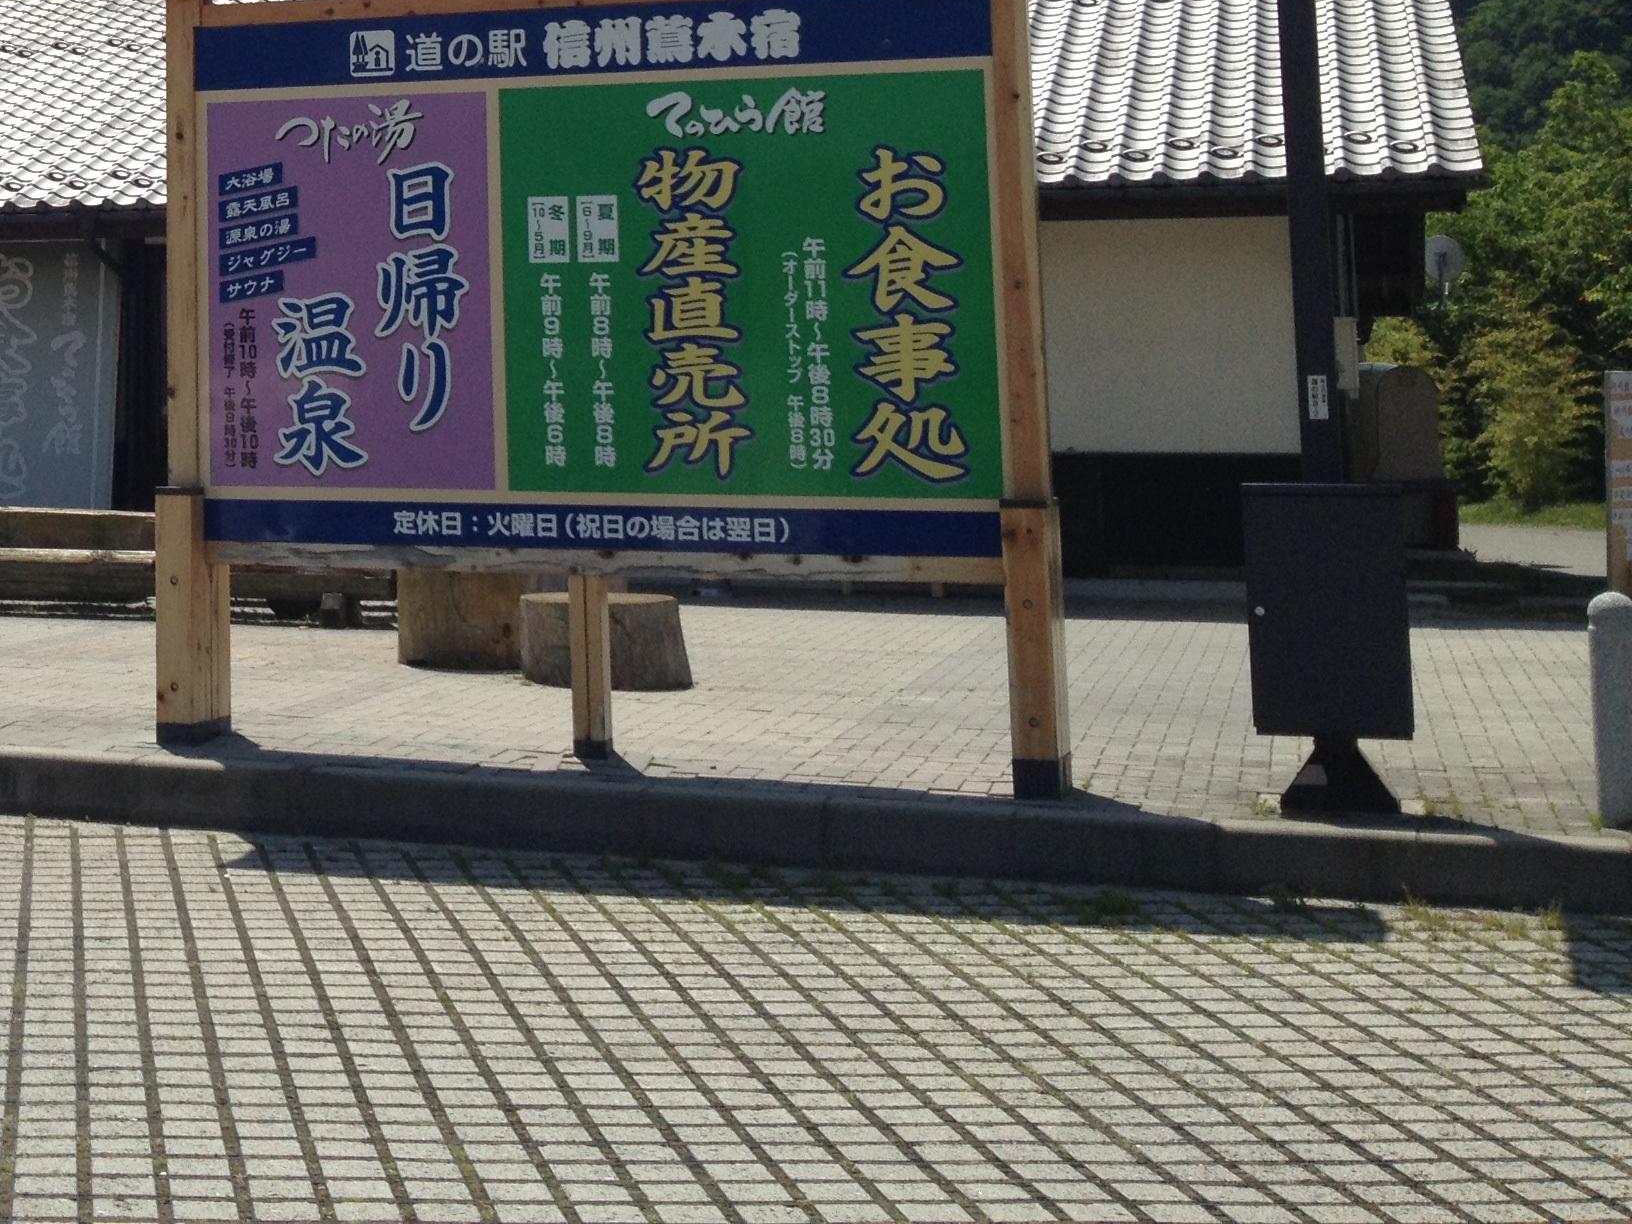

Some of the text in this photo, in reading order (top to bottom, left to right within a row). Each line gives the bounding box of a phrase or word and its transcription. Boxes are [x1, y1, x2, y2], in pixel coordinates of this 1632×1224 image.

[405, 9, 801, 73] 道の駅 信州蔦木宿
[275, 99, 423, 165] つたの湯
[646, 88, 826, 138] てのひら館
[225, 167, 275, 193] 大浴場
[225, 192, 291, 220] 露天風呂
[225, 218, 292, 246] 源泉の湯
[226, 276, 275, 299] サウナ
[374, 161, 469, 432] 日帰り
[635, 146, 754, 479] 物産直売所
[842, 145, 971, 482] お食事処
[271, 291, 369, 476] 温泉
[540, 272, 567, 467] 午前9時～午後6時
[589, 272, 616, 467] 午前8時～午後8時
